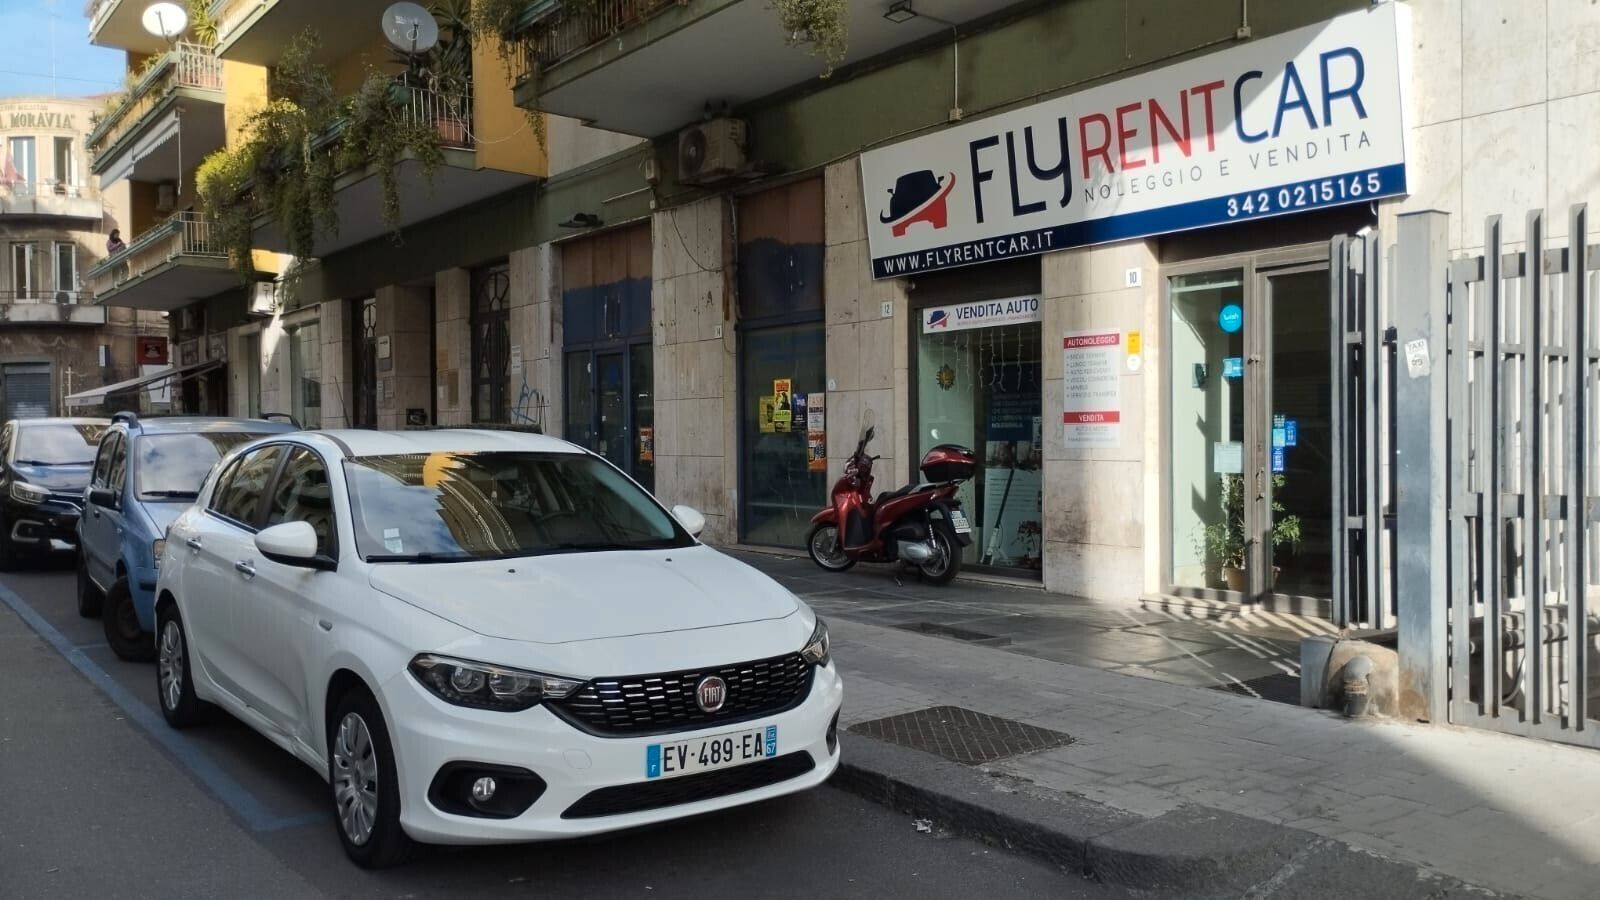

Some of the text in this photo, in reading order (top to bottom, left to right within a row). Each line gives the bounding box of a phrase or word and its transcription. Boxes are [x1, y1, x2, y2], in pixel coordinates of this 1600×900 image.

[1085, 130, 1371, 204] NOLEGGIO E VENDITA
[1226, 172, 1381, 217] 342 0215165
[884, 231, 1054, 274] WWW.FLYRENTCAR.IT
[884, 304, 890, 314] 12
[955, 303, 1003, 320] VENDITA
[1006, 298, 1039, 314] AUTO
[1067, 335, 1116, 347] AUTONOLEGGIO
[1079, 414, 1104, 422] VENDITA
[704, 686, 721, 703] FIAT
[651, 765, 656, 773] F
[766, 742, 775, 754] 67
